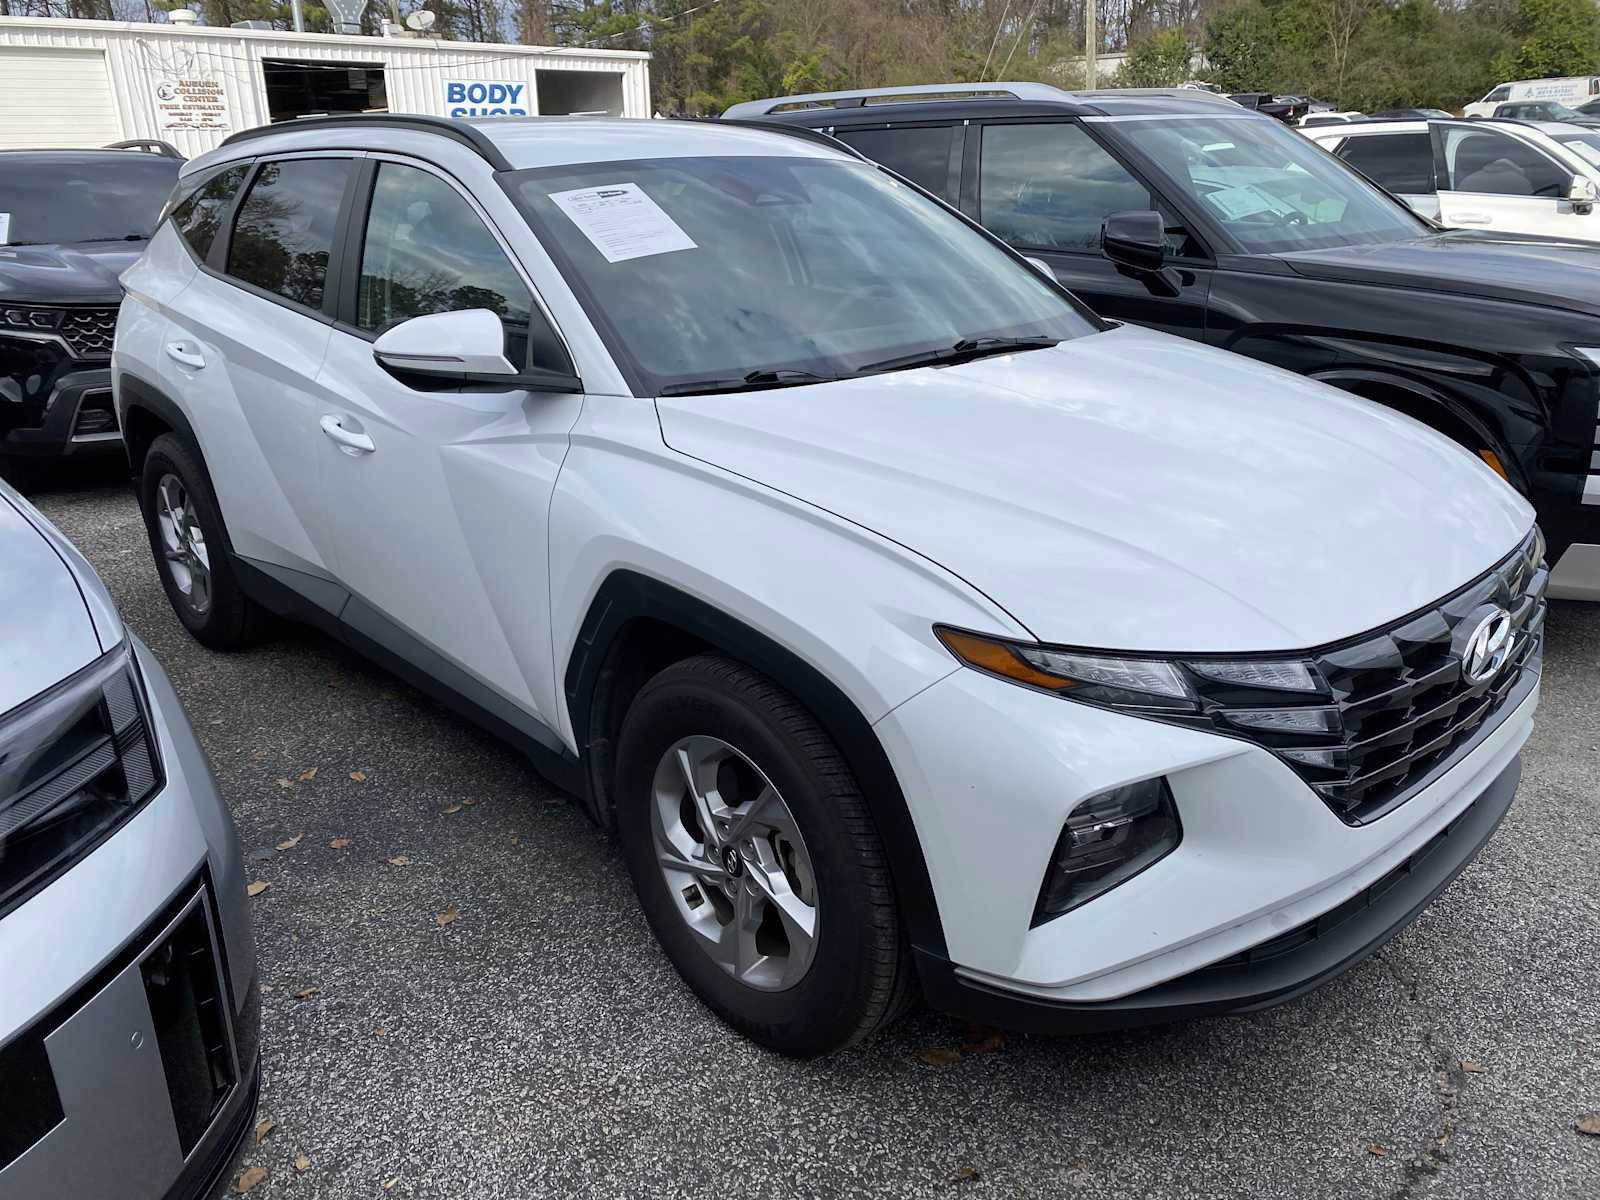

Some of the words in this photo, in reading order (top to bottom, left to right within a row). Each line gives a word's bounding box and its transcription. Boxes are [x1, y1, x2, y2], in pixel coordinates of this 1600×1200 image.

[178, 80, 219, 88] AUBURN
[173, 87, 224, 96] COLLISION
[447, 82, 524, 104] BODY
[182, 95, 219, 103] CENTER
